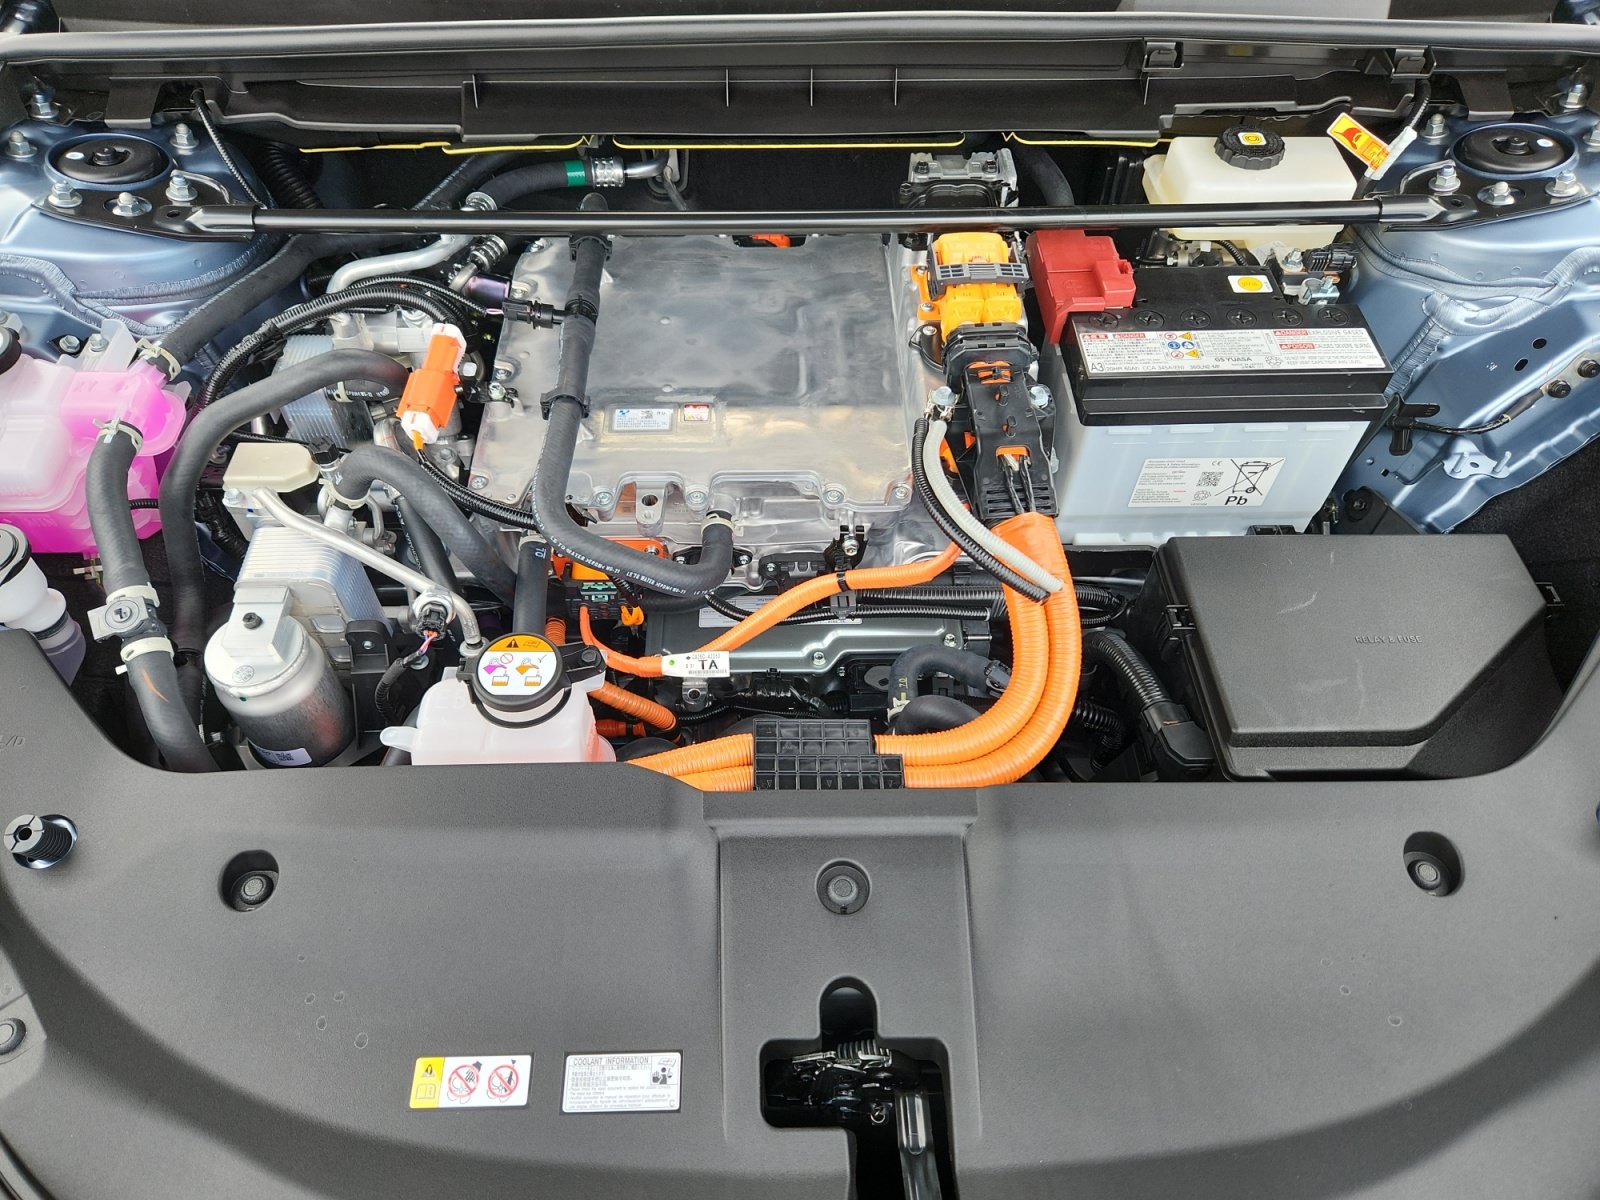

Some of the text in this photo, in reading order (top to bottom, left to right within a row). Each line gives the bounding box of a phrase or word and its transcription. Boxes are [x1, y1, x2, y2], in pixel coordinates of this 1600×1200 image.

[1091, 362, 1104, 372] A3
[1224, 496, 1248, 505] Pb
[1355, 635, 1386, 644] RELAY
[1397, 635, 1423, 643] FUSE
[698, 660, 718, 670] TA
[573, 1056, 649, 1066] COOLANT INFORMATION
